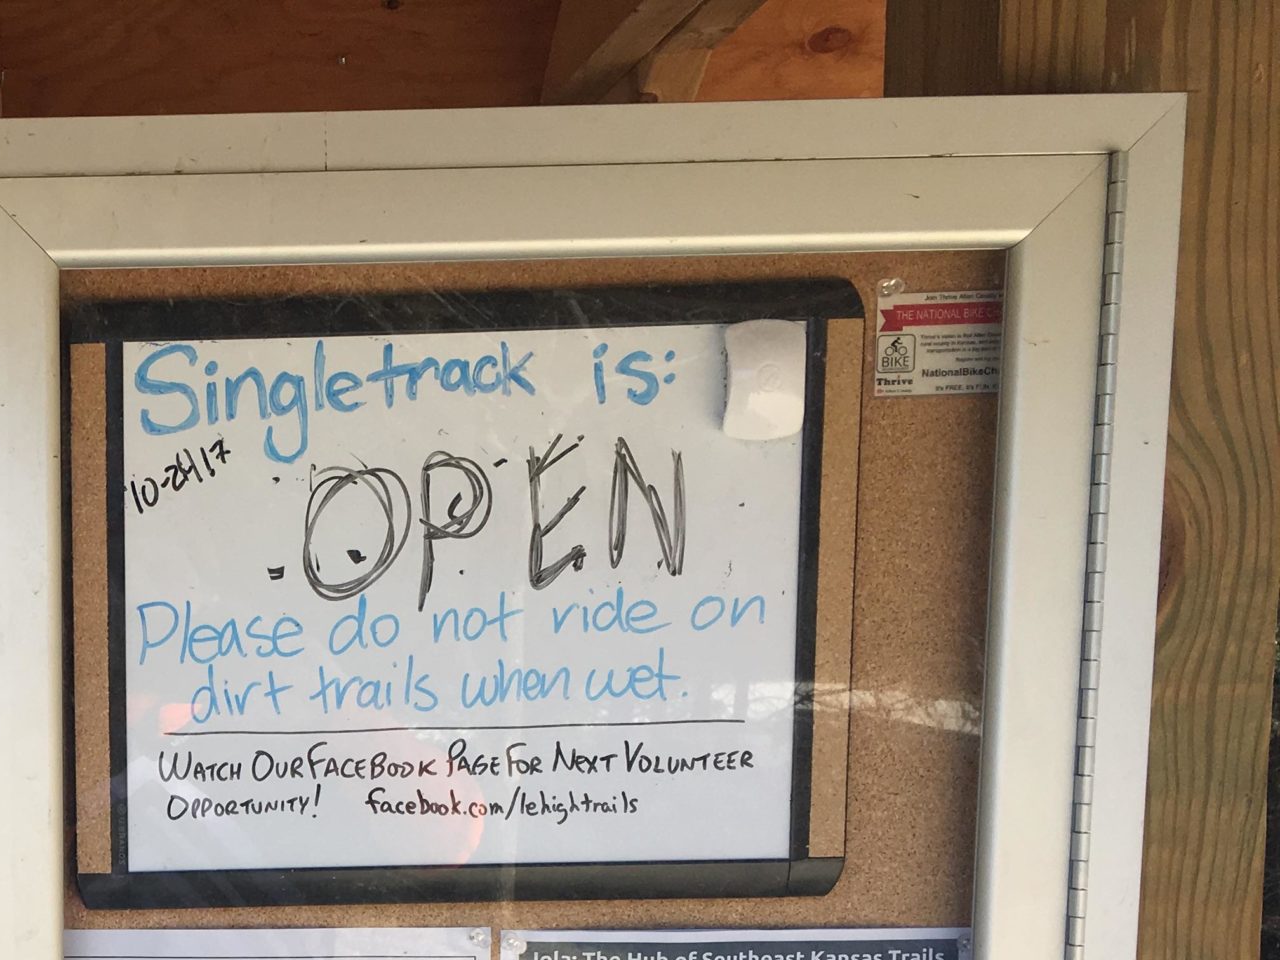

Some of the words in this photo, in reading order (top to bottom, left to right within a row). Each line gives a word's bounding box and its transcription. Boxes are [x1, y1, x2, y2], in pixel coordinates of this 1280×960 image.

[896, 310, 914, 321] THE
[916, 309, 961, 320] NATIONAL
[876, 376, 913, 386] Thrive
[881, 356, 910, 368] BIKE
[133, 340, 537, 465] Singletrack
[594, 342, 679, 405] is:
[302, 434, 687, 612] OPEN
[137, 598, 303, 666] Please
[328, 594, 400, 655] do
[431, 600, 524, 644] not
[552, 588, 673, 636] ride
[690, 594, 767, 629] on
[191, 666, 293, 726] dirt
[311, 661, 439, 714] trails
[458, 660, 571, 709] when
[585, 647, 688, 702] wet.
[365, 786, 639, 822] facebook.com/lehightrails
